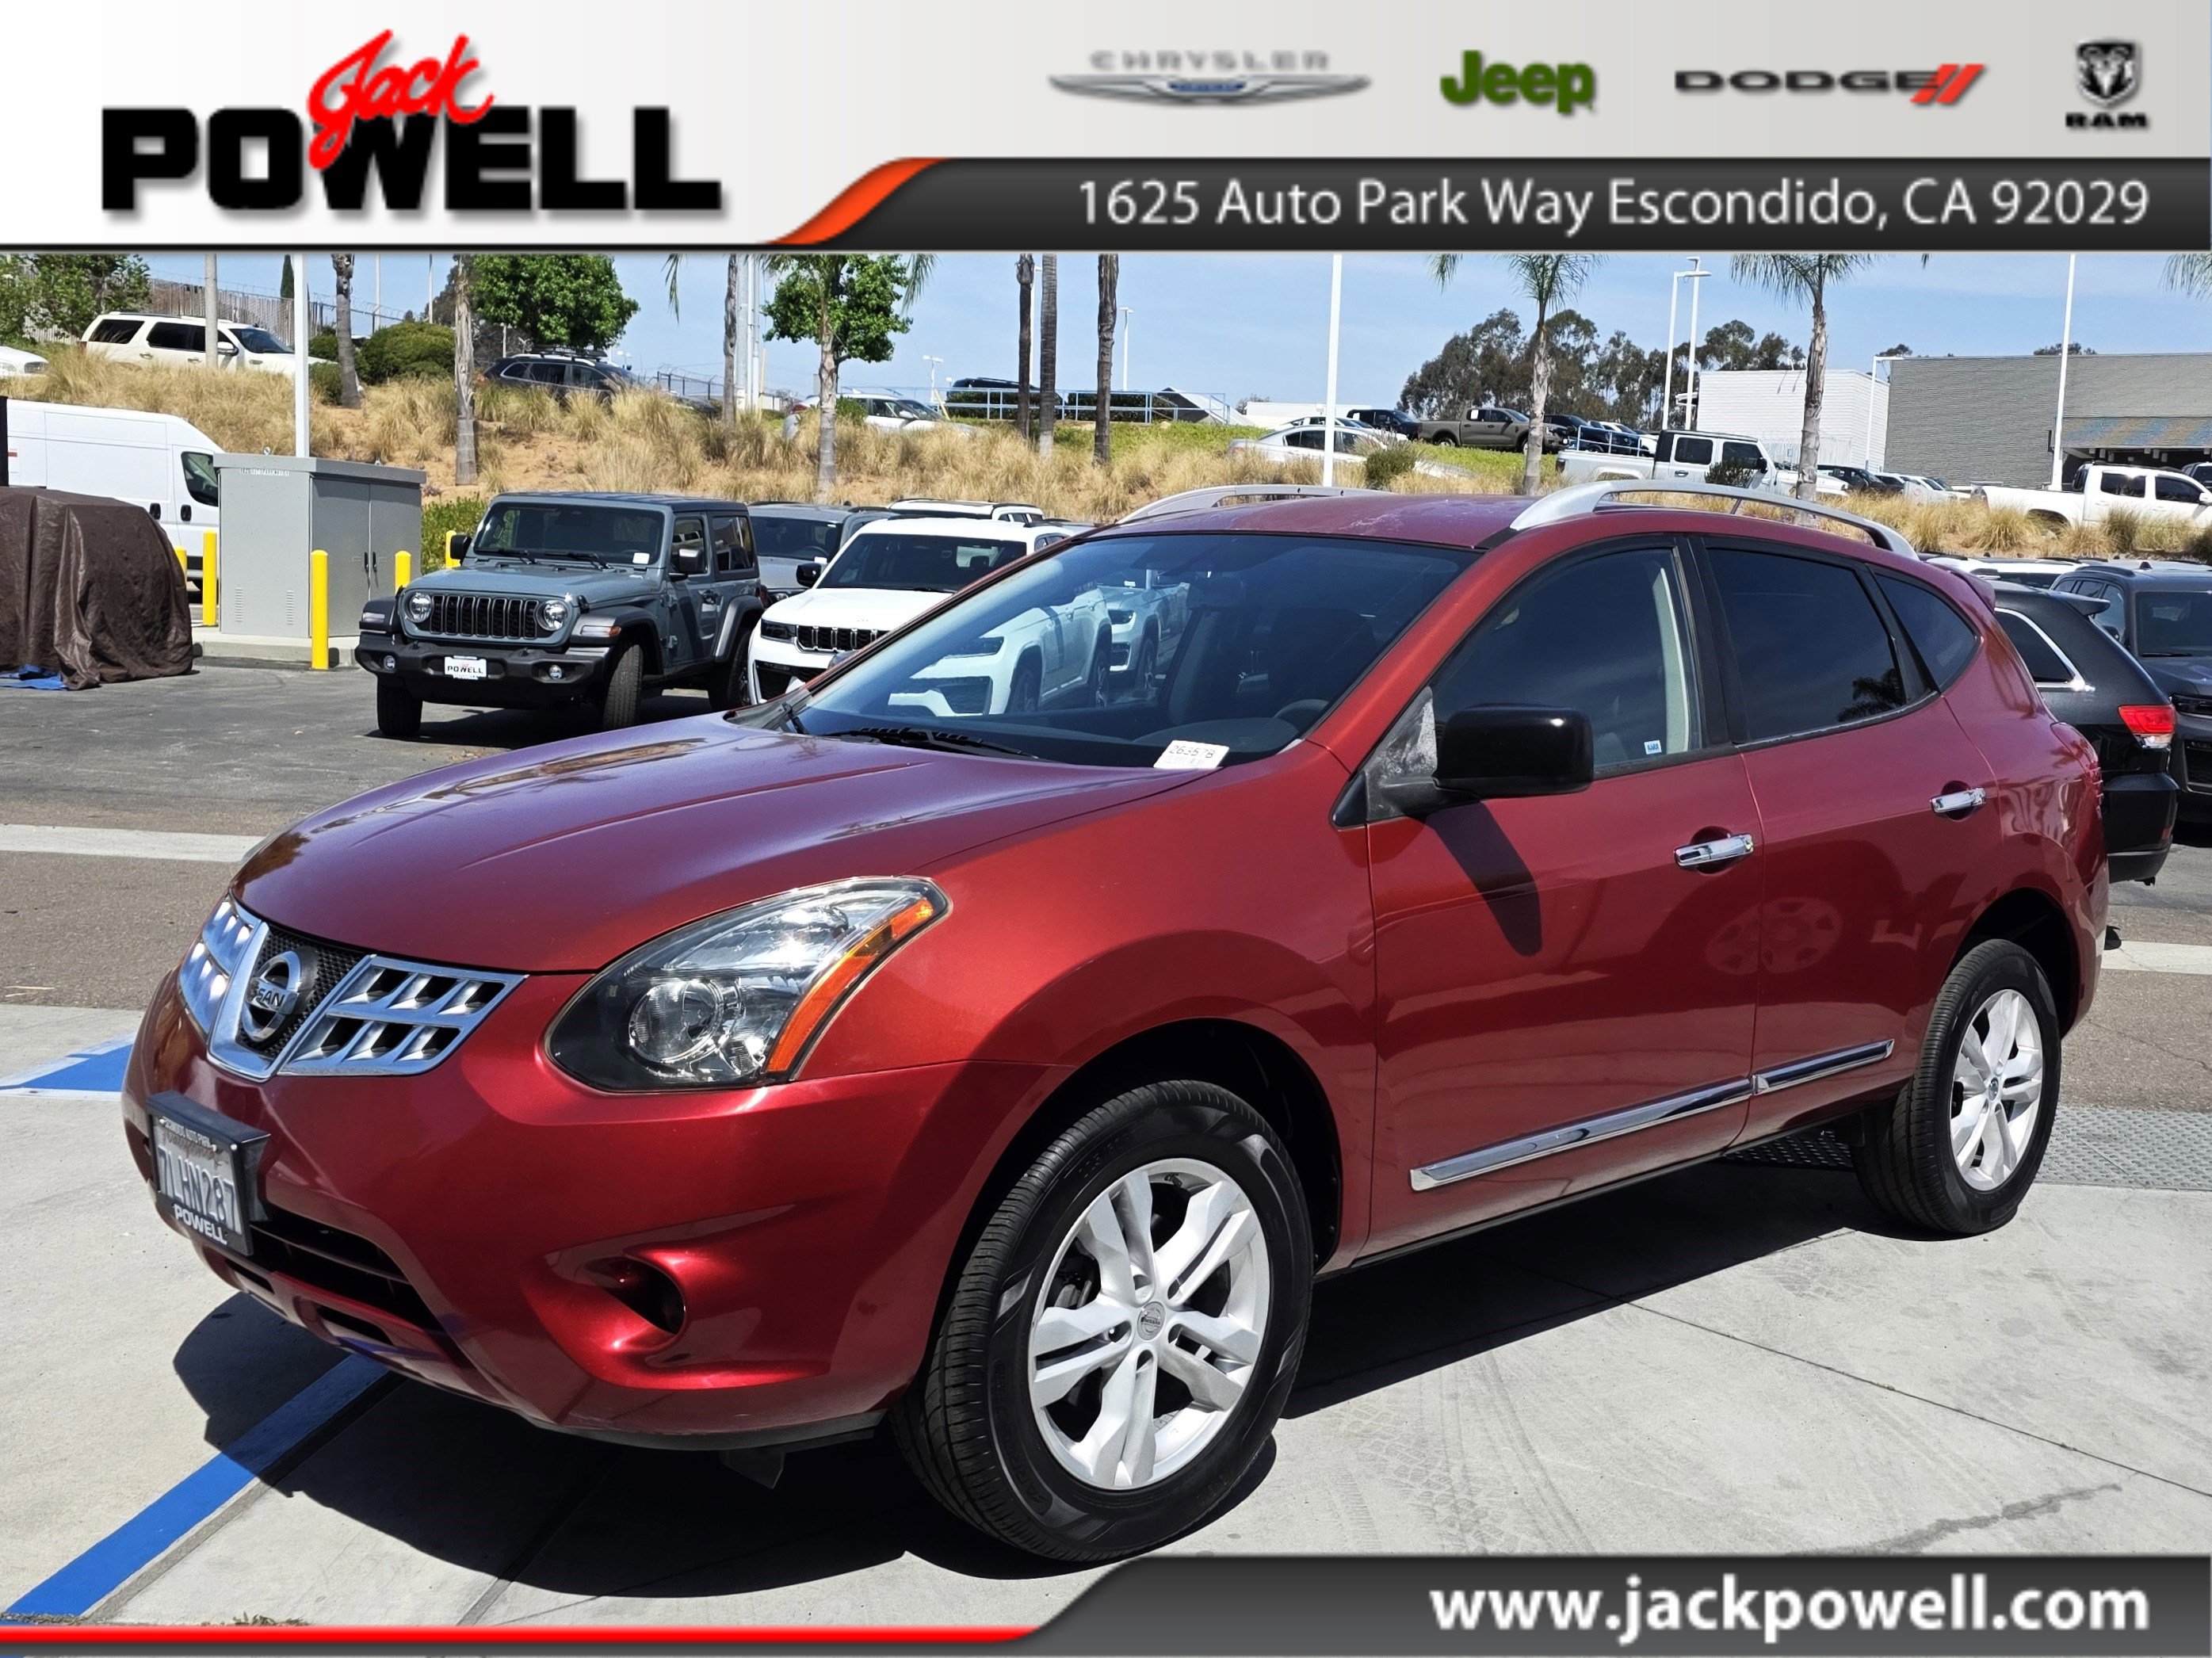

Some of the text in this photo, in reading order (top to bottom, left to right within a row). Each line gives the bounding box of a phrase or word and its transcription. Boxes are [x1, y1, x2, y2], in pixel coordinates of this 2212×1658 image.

[447, 665, 483, 674] POWELL
[157, 1144, 243, 1236] 7LHN287
[174, 1203, 227, 1245] POWELL
